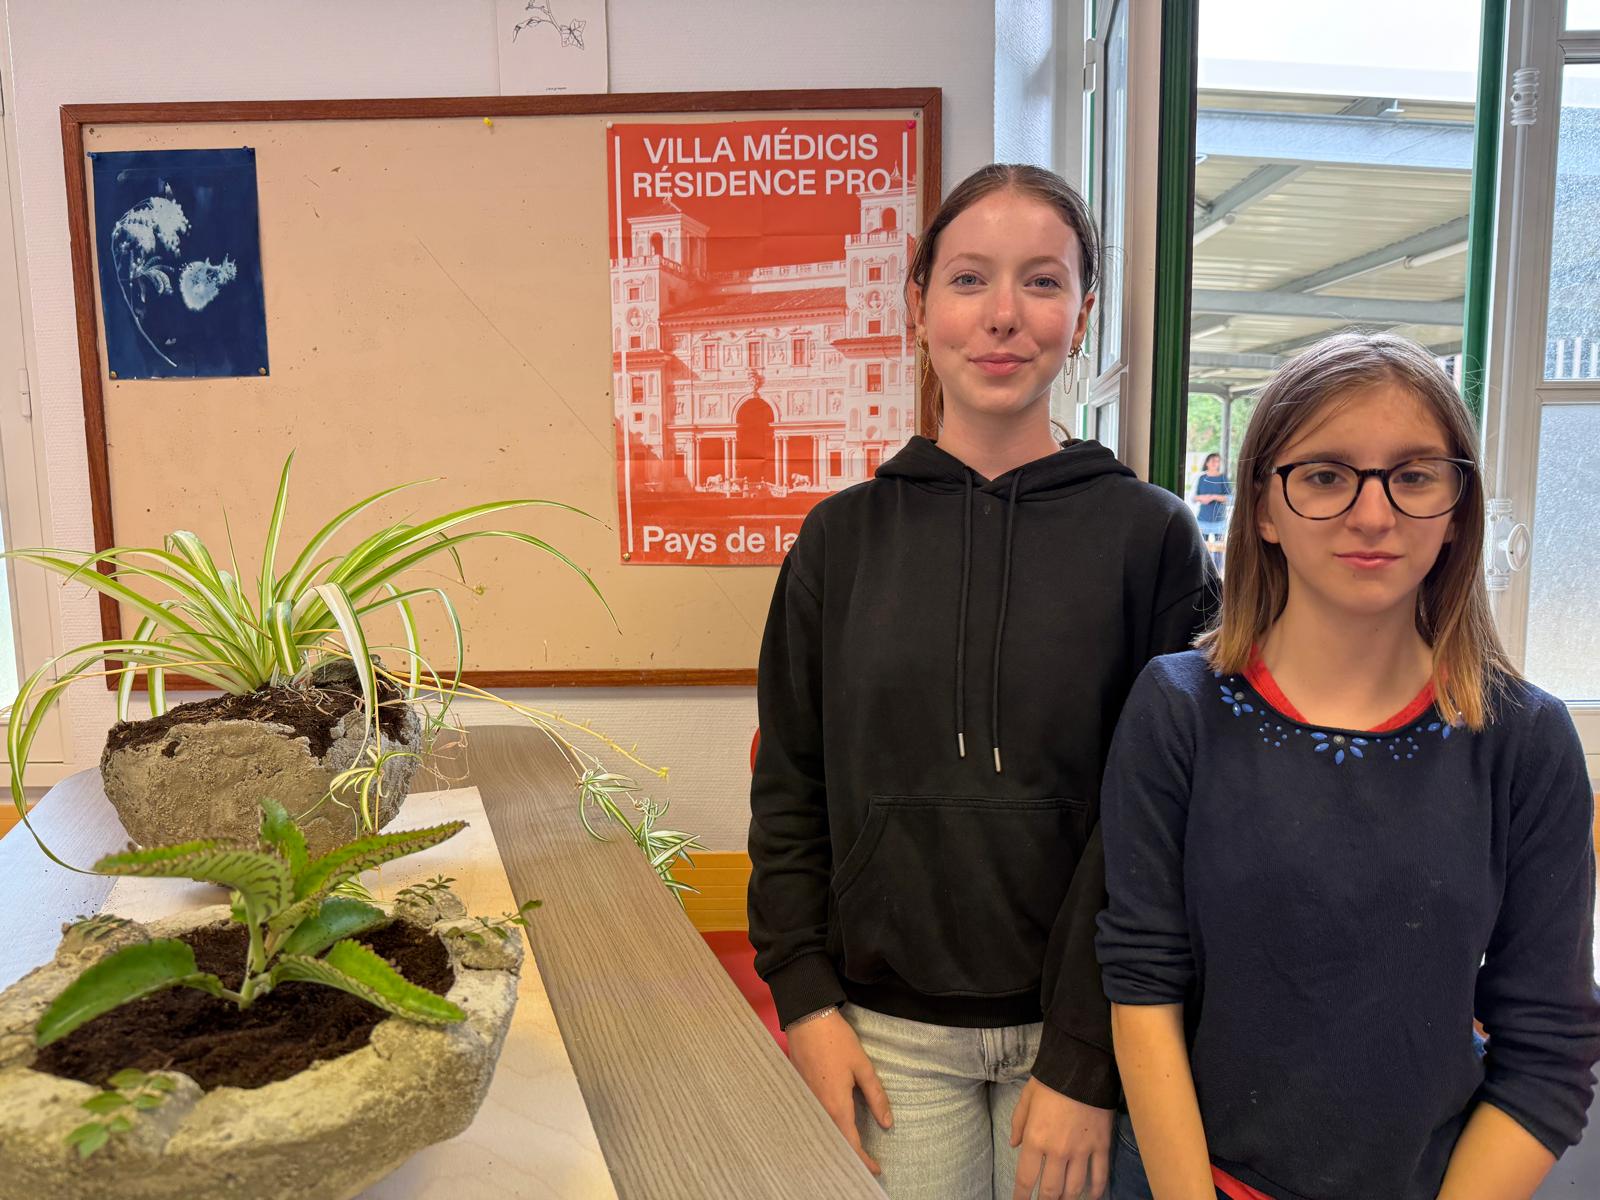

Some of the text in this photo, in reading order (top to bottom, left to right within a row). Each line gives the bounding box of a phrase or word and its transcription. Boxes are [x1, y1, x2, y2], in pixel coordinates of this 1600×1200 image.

[643, 127, 879, 164] VILLA MÉDICIS
[632, 165, 892, 198] RÉSIDENCE PRO
[643, 526, 799, 560] Pays de la
